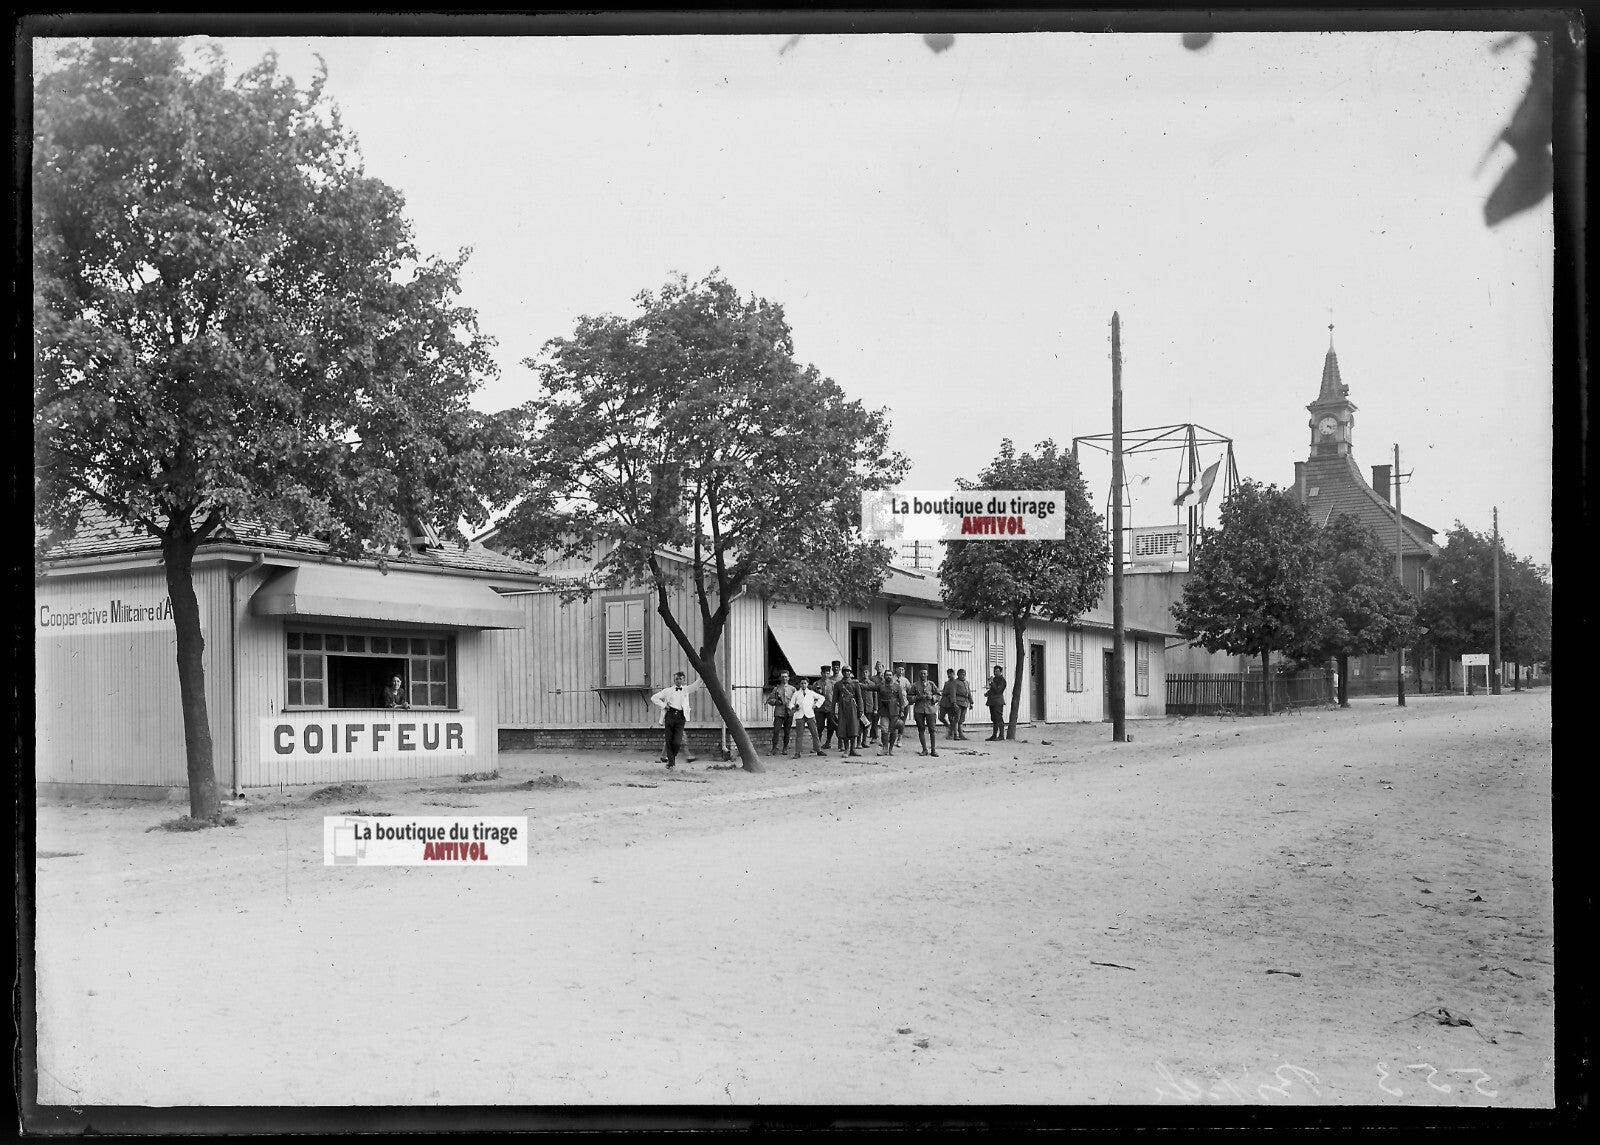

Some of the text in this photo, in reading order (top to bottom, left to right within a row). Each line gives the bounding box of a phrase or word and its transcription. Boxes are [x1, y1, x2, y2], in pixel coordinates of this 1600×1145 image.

[111, 600, 154, 623] Militaire
[156, 596, 174, 621] d'A
[273, 722, 464, 755] COIFFEUR
